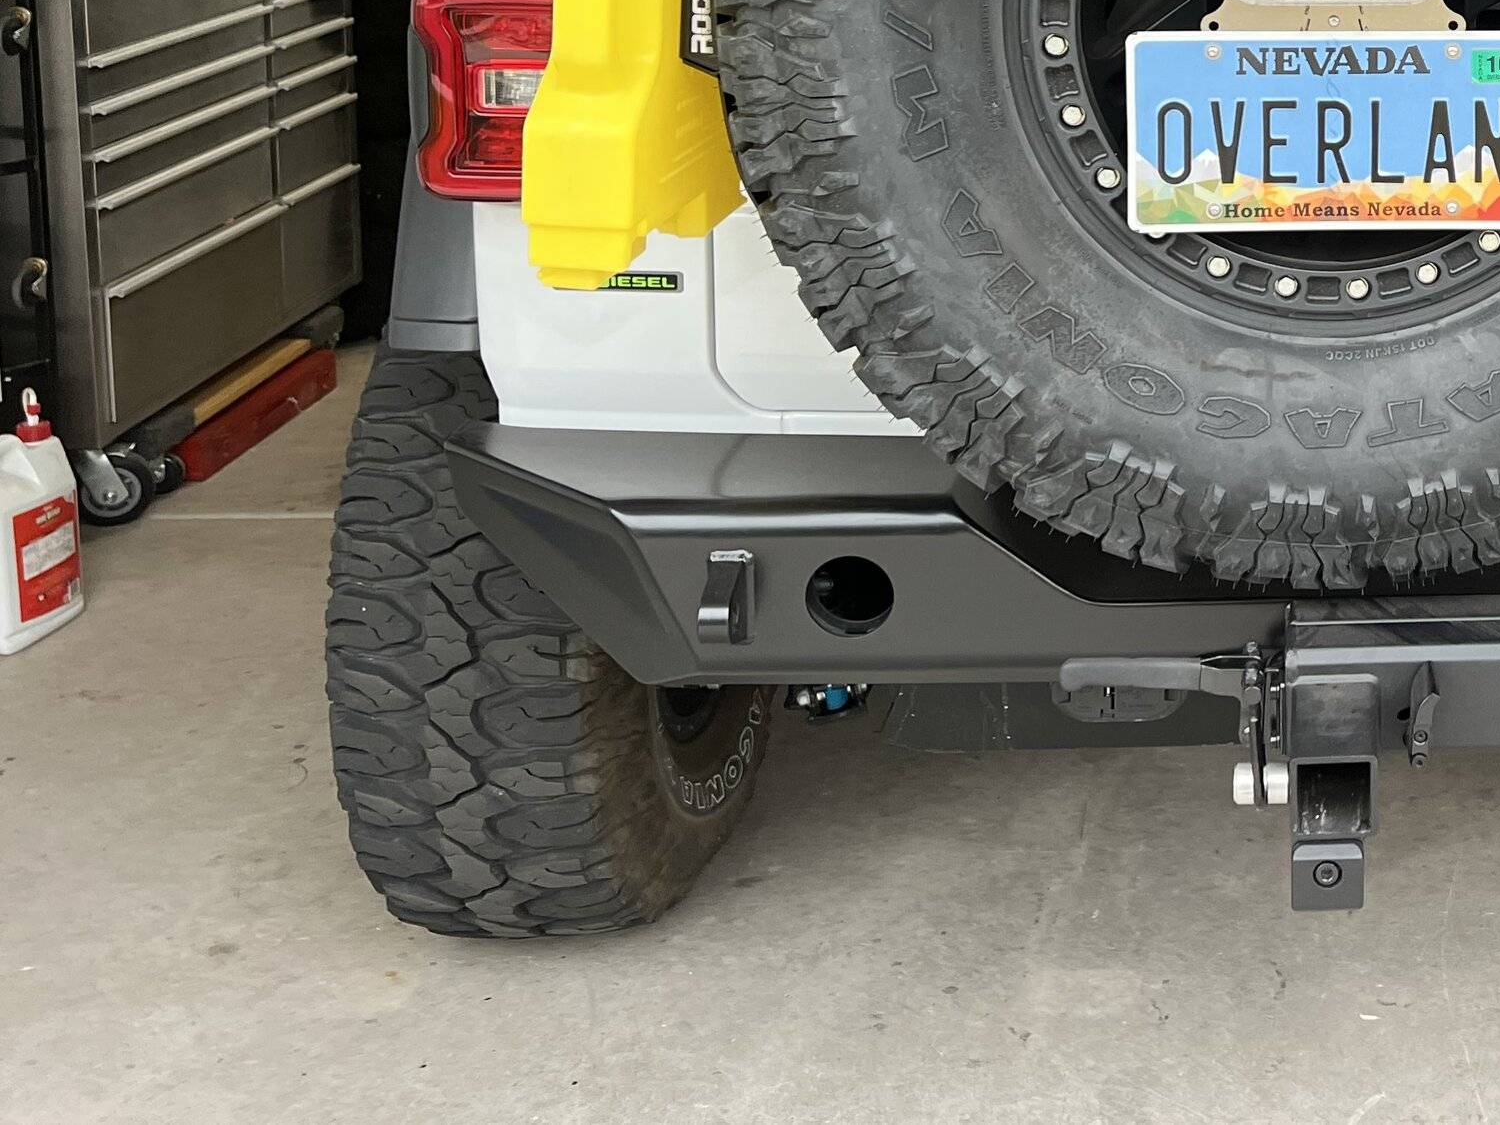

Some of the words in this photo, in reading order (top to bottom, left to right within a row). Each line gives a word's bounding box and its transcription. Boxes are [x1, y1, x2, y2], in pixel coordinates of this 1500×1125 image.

[1236, 45, 1430, 75] NEVADA
[1224, 202, 1285, 218] Home
[1293, 202, 1360, 218] Means
[1367, 201, 1442, 218] Nevada
[1408, 332, 1435, 352] DOT
